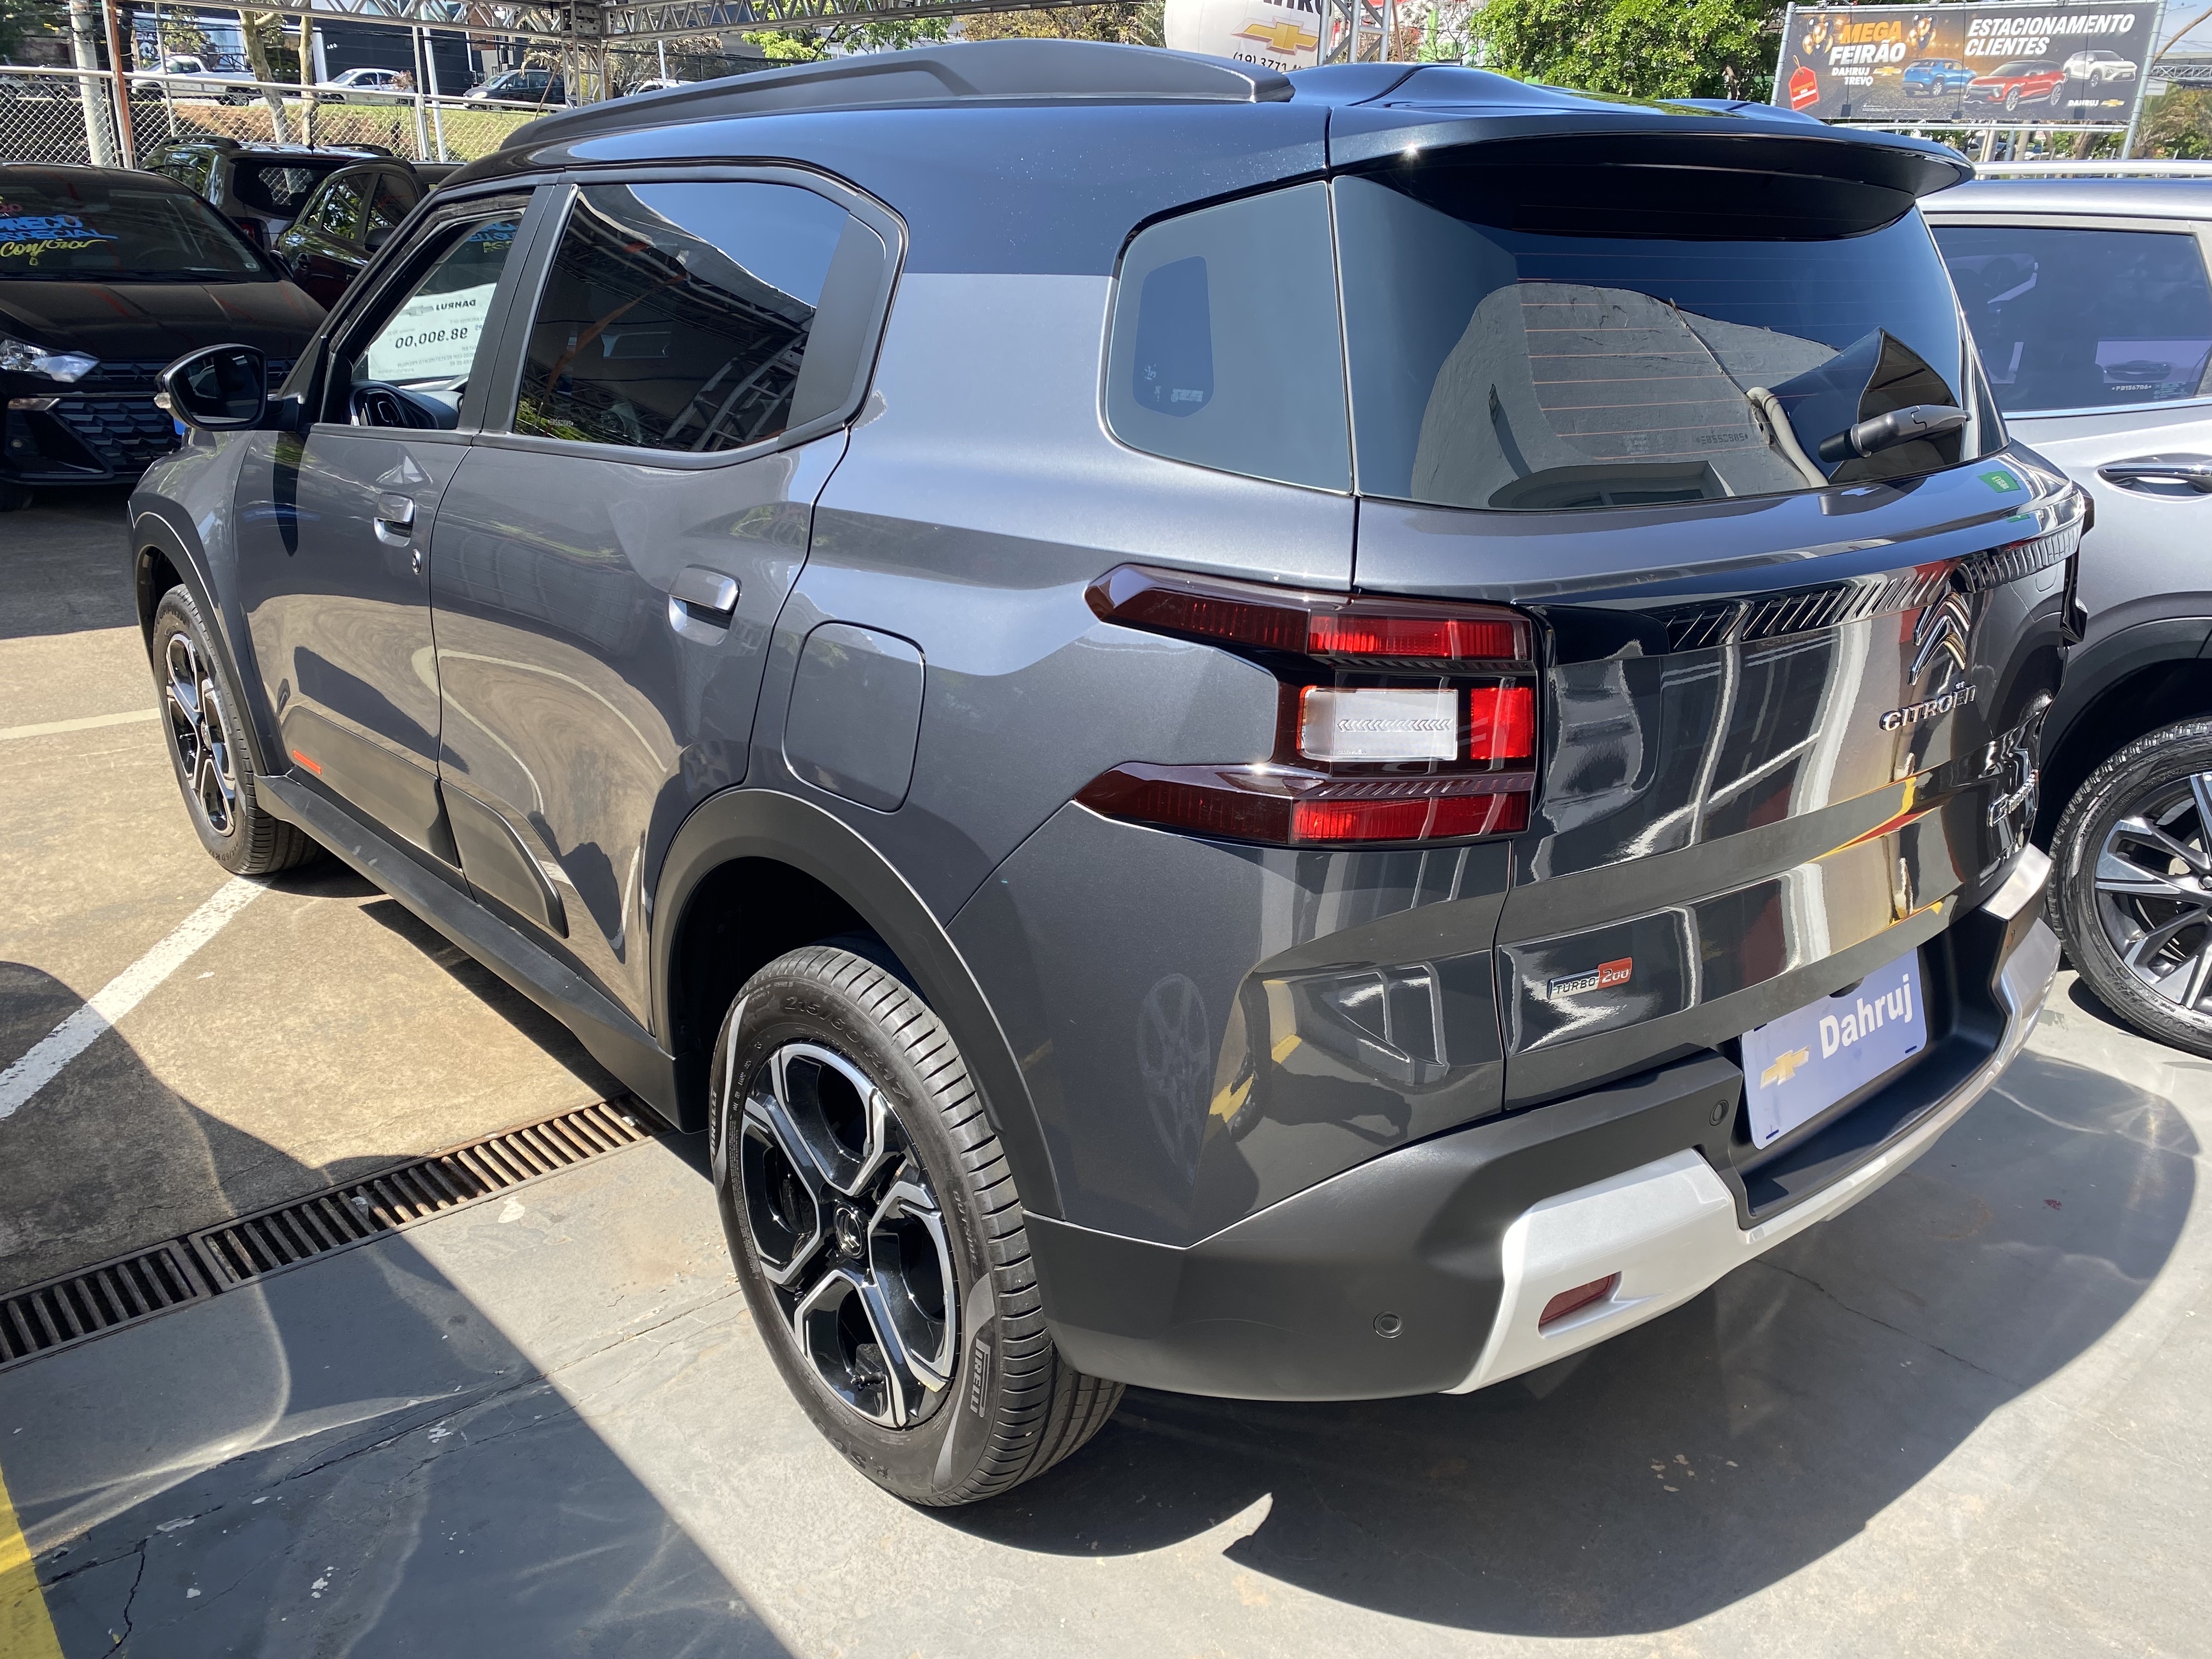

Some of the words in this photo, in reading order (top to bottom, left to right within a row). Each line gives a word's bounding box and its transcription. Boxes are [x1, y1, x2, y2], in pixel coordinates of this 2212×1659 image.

[1840, 21, 1902, 44] MEGA
[1967, 14, 2136, 37] ESTACIONAMENTO
[1829, 39, 1906, 66] FEIRÃO
[1965, 36, 2050, 56] CLIENTES
[1831, 67, 1870, 76] DAHRUJ
[1844, 76, 1874, 87] TREVO
[1879, 681, 1977, 731] CITROËN
[1556, 977, 1596, 995] TURBO
[1601, 968, 1629, 984] 200
[1819, 973, 1913, 1060] Dahruj
[969, 1337, 990, 1419] PIRELLI
